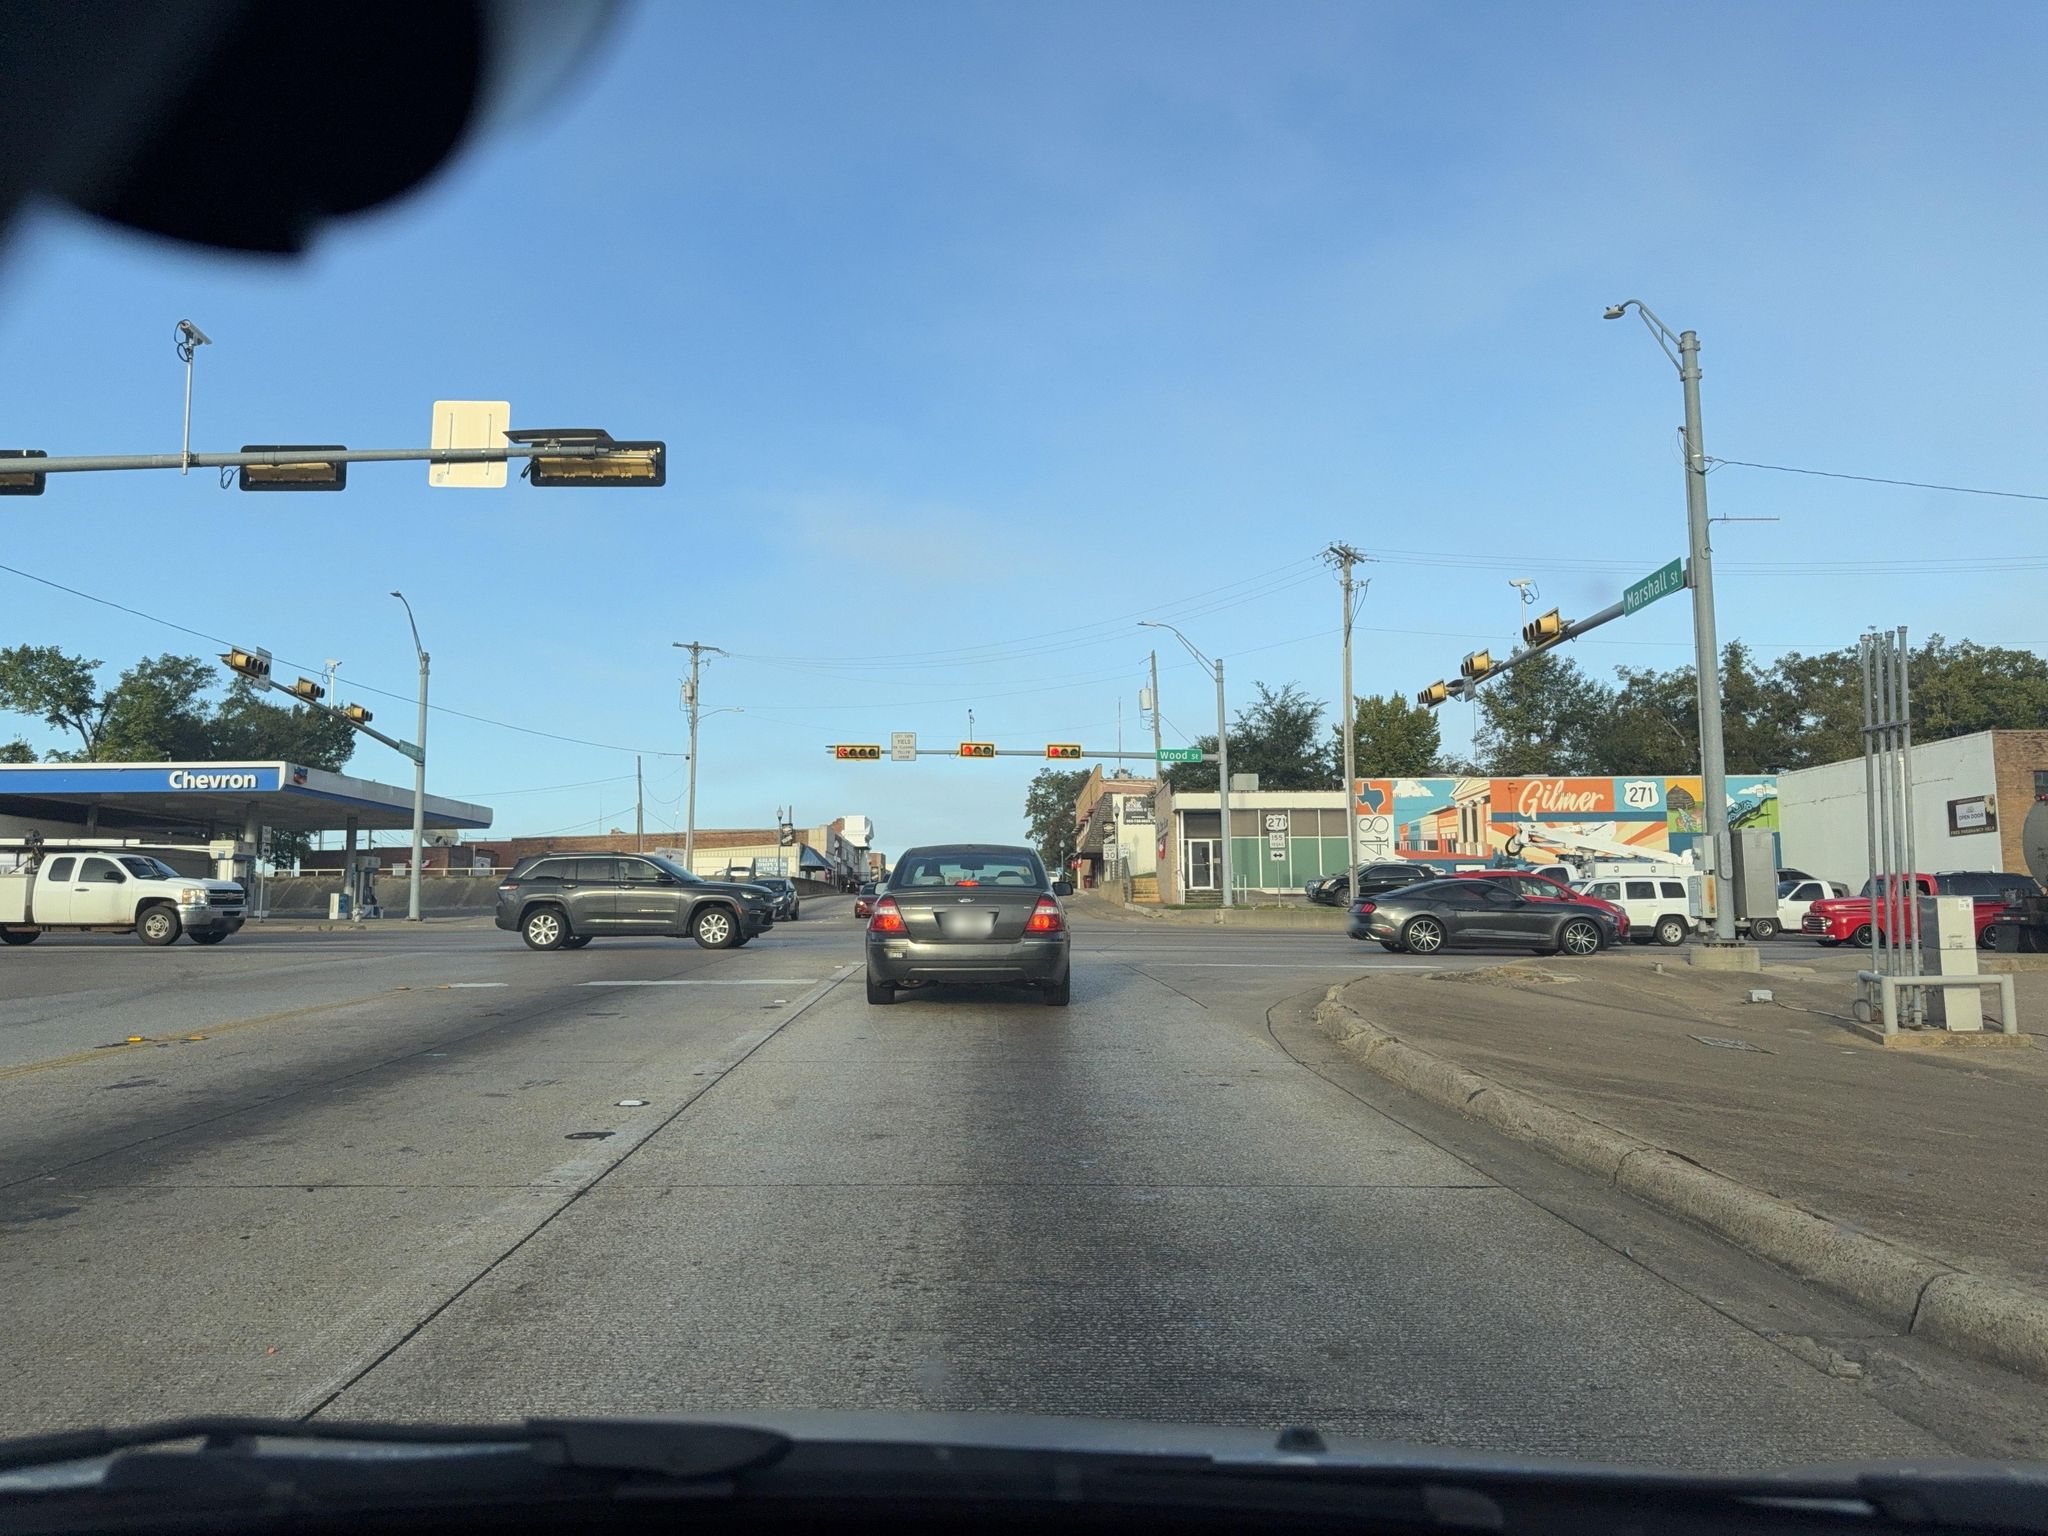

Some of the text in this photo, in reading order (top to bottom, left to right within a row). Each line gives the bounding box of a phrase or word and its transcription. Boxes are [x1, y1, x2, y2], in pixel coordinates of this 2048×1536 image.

[1626, 570, 1679, 610] Marshall St
[1160, 751, 1188, 760] Wood
[169, 770, 257, 789] Chevron
[1518, 780, 1604, 821] Gilmer
[1629, 786, 1653, 803] 271
[1268, 817, 1286, 827] 271
